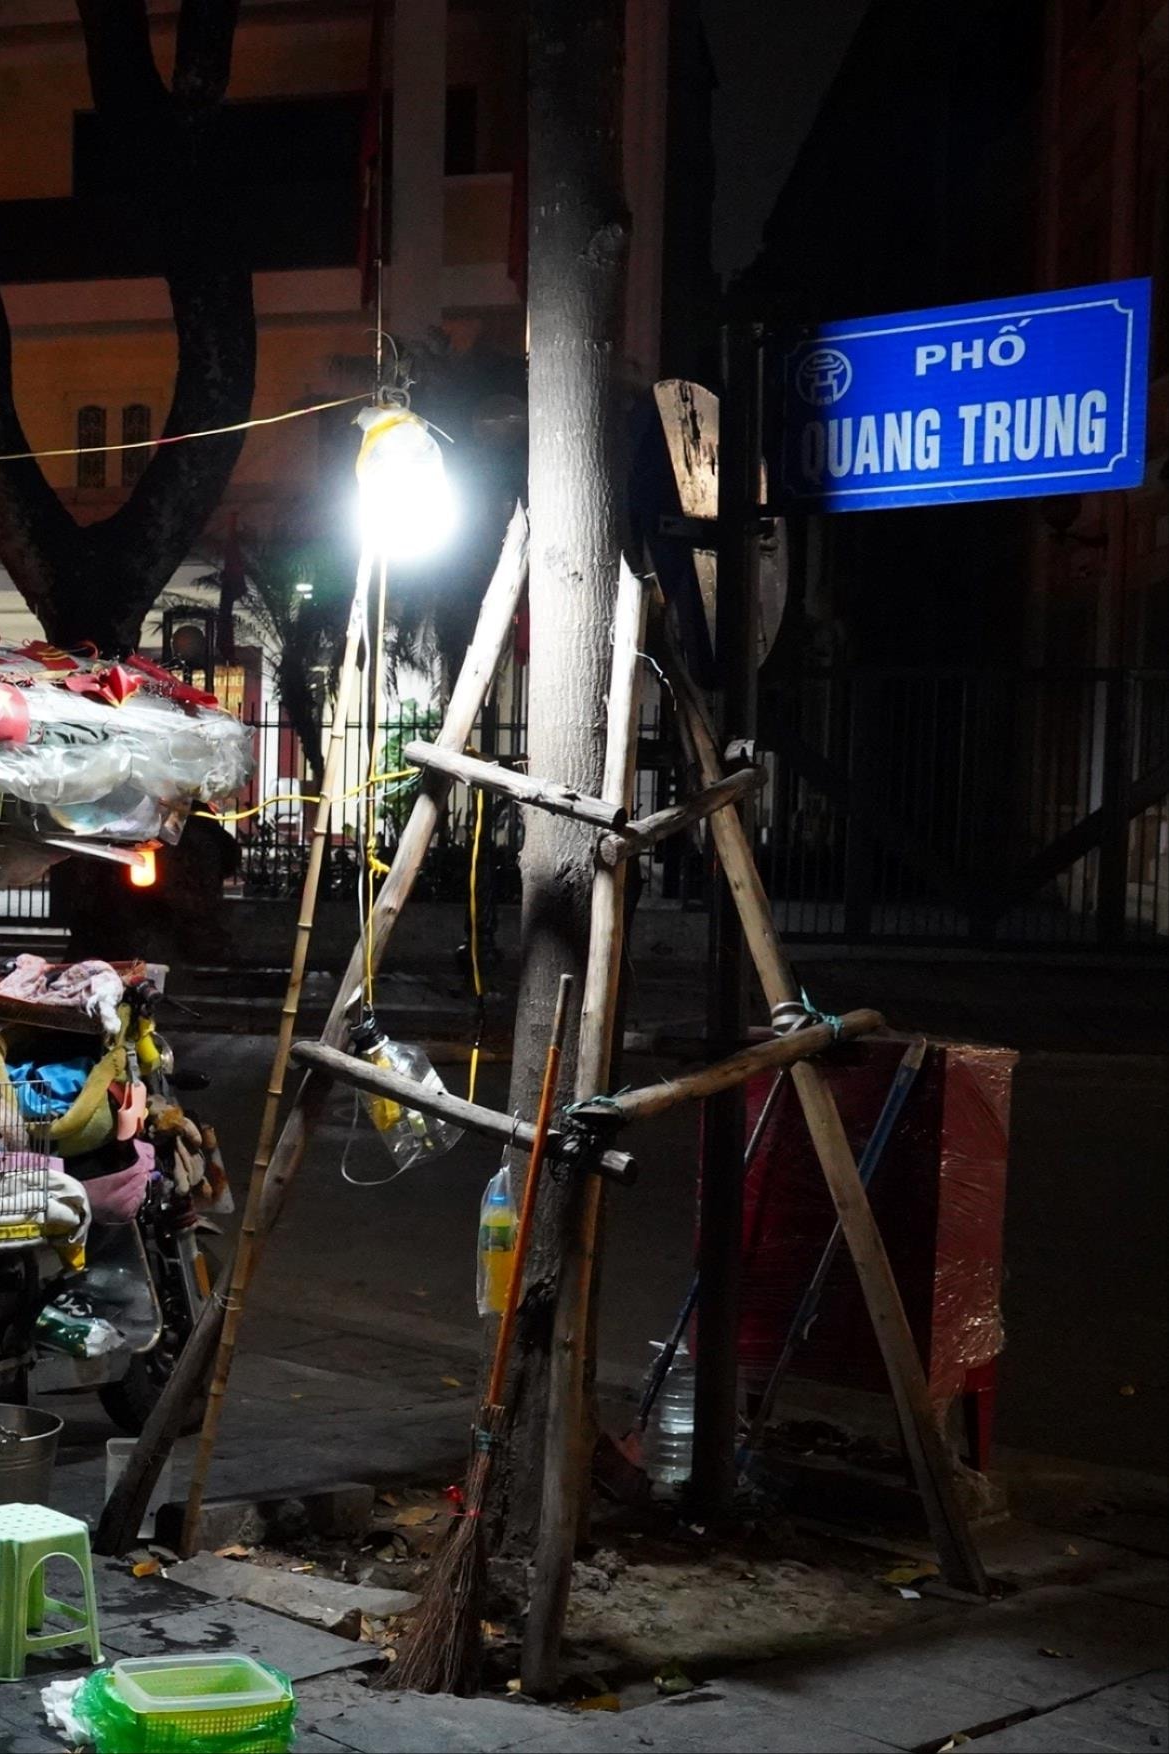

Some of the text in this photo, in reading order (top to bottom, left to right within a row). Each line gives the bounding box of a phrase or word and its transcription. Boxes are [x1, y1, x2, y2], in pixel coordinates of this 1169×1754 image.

[915, 318, 1032, 377] PHỐ
[800, 389, 1108, 487] QUANG TRUNG
